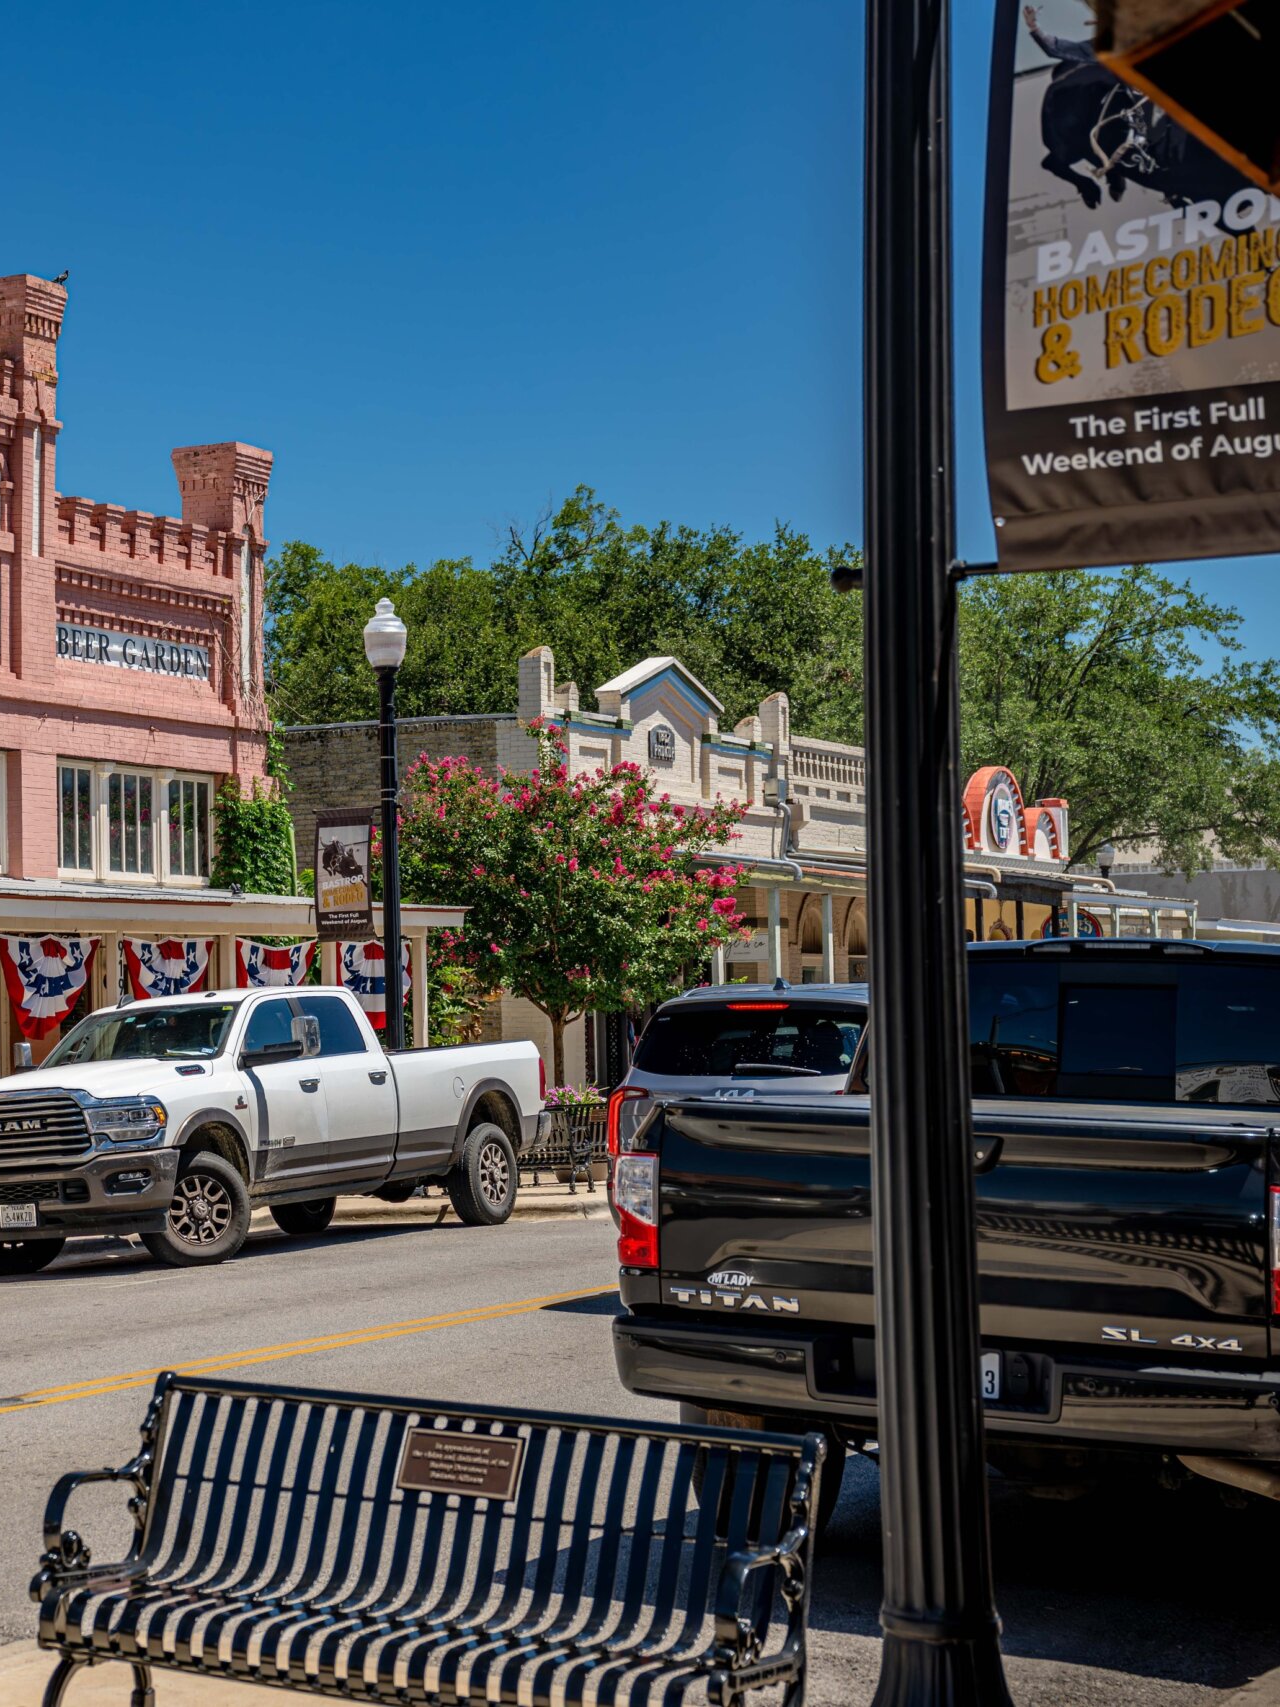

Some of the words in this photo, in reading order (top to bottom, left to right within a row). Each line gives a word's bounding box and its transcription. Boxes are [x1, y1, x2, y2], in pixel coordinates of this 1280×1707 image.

[1033, 226, 1280, 328] HOMECOMIN
[1035, 323, 1082, 384] &
[1070, 415, 1127, 439] The
[1134, 406, 1202, 432] First
[1209, 397, 1266, 424] Full
[1022, 441, 1163, 476] Weekend
[1171, 436, 1203, 461] of
[56, 626, 111, 662] BEER
[122, 638, 209, 677] GARDEN
[322, 874, 364, 889] BASTROP
[670, 1287, 800, 1313] TITAN
[1101, 1326, 1158, 1344] SL
